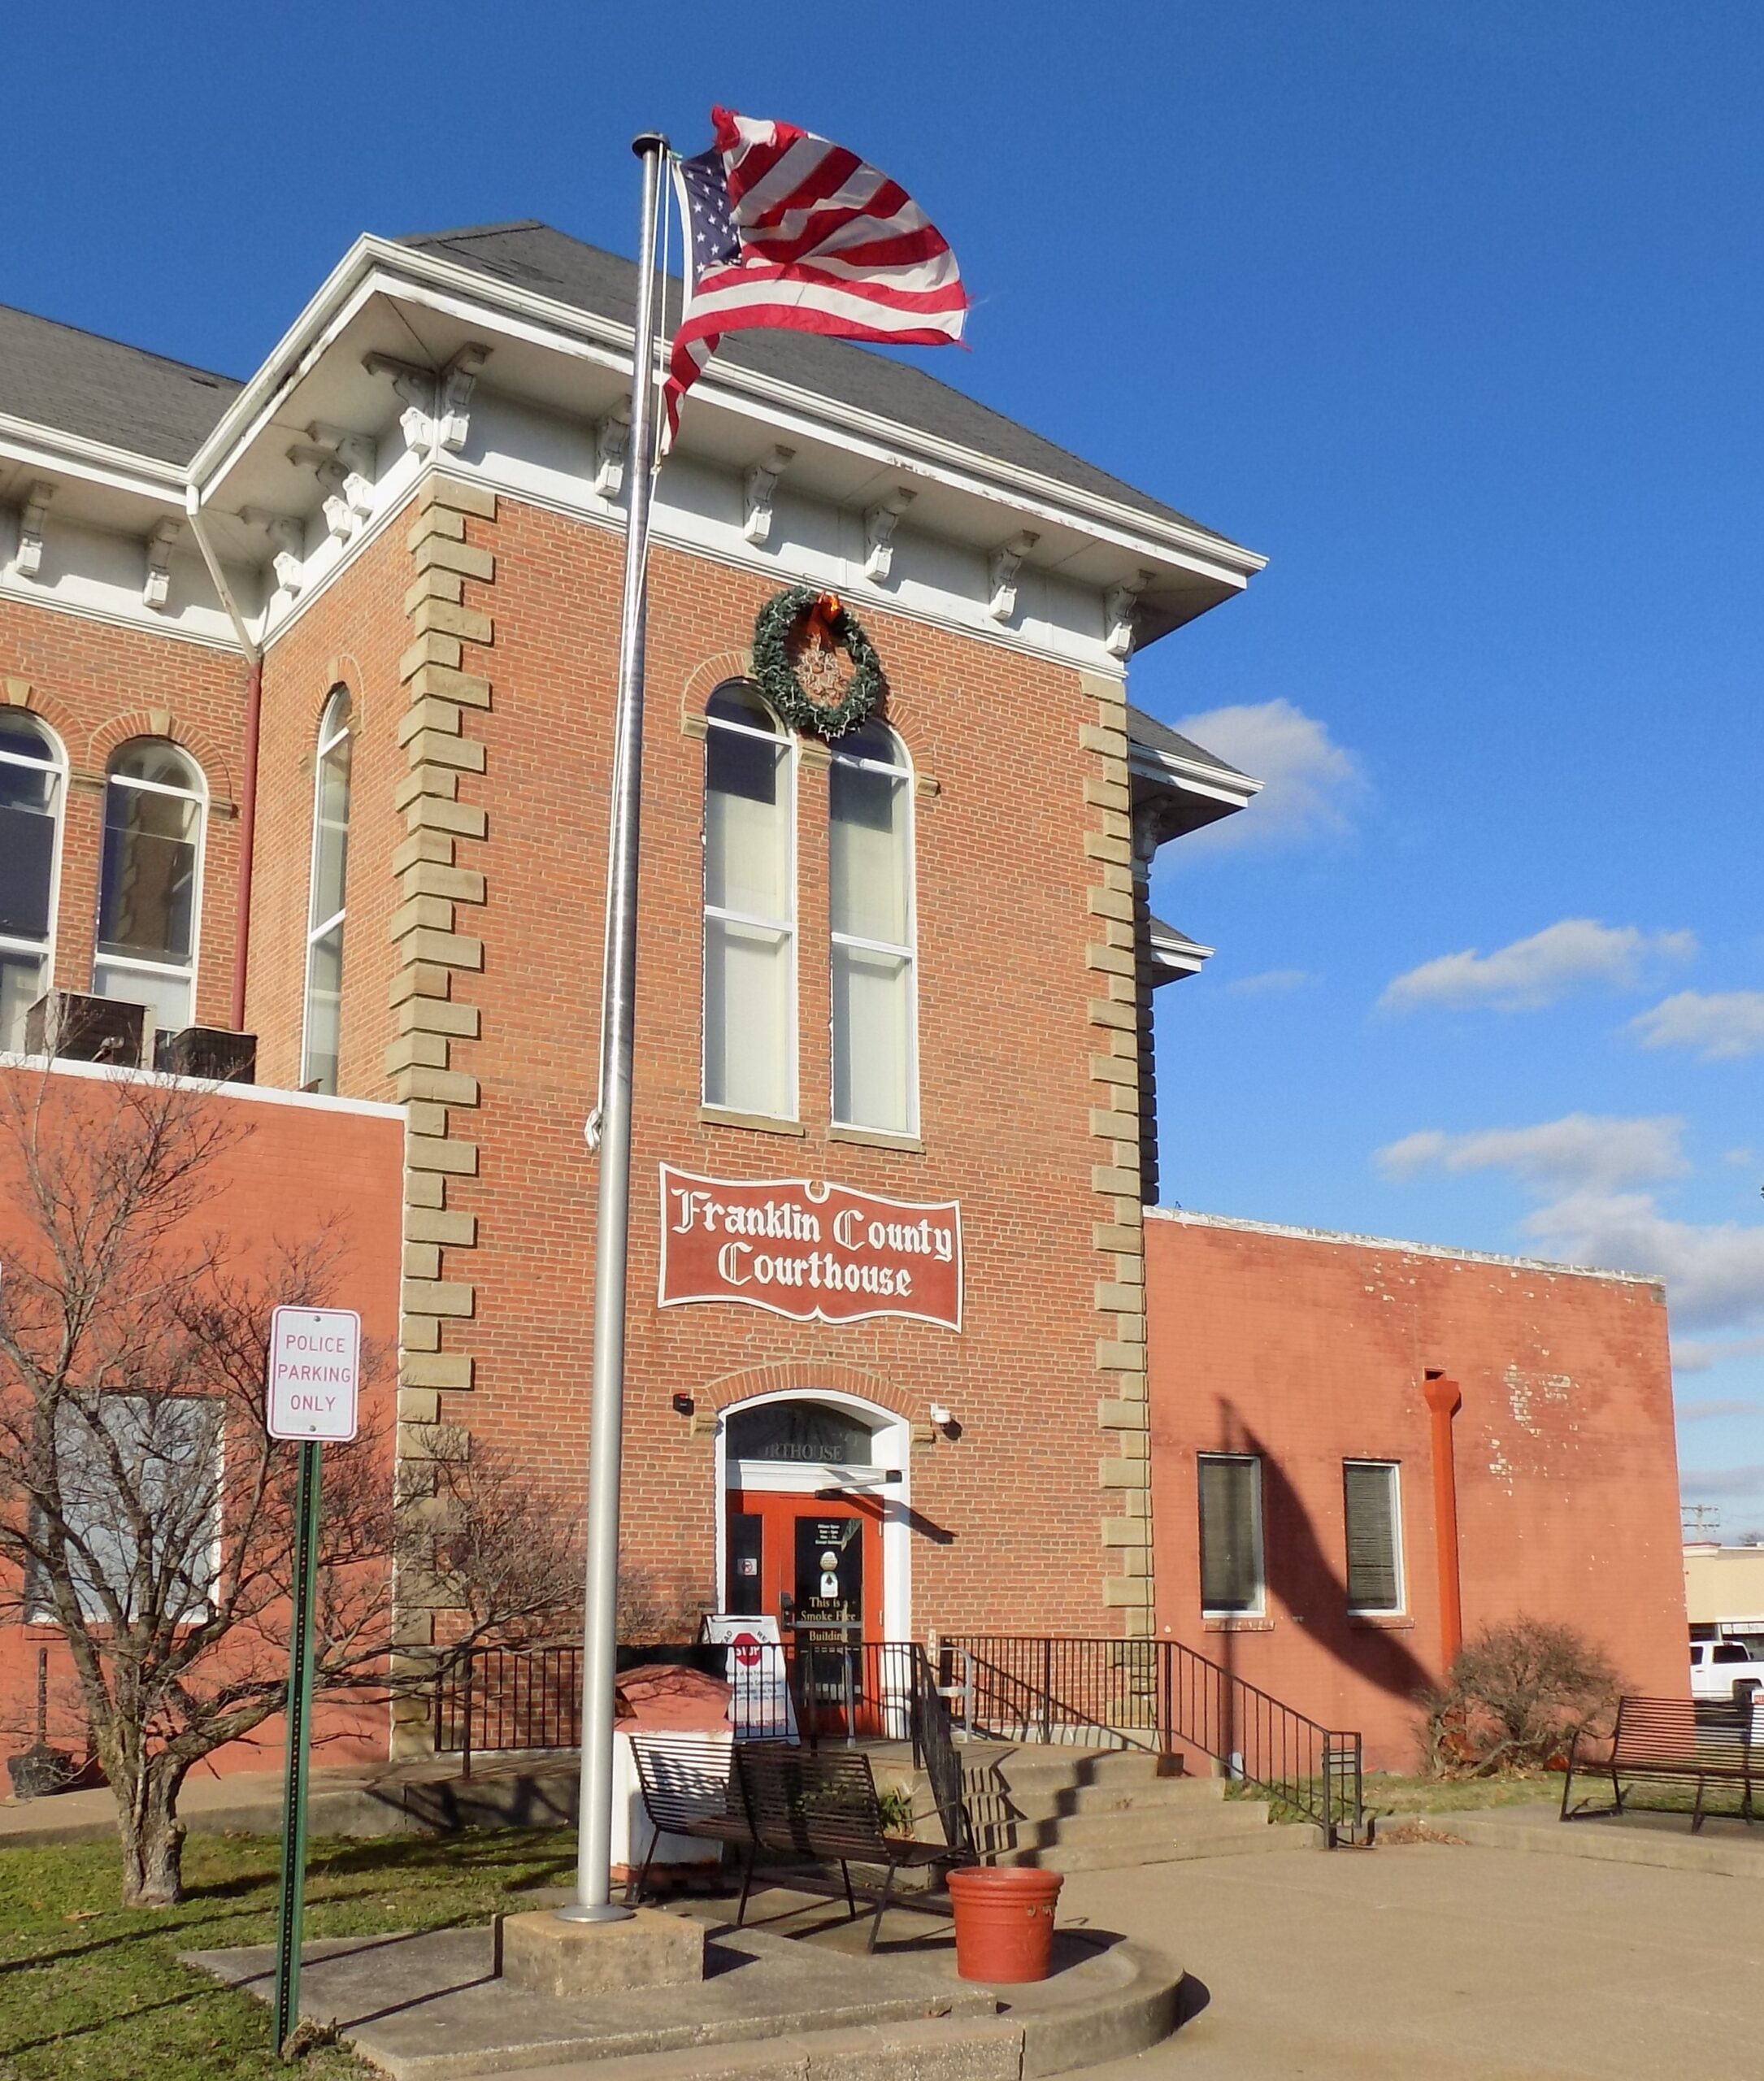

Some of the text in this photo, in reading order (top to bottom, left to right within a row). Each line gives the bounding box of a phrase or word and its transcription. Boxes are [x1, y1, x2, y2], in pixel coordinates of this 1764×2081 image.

[671, 1187, 953, 1262] Franklin County
[718, 1241, 913, 1297] Courthouse
[286, 1335, 345, 1353] POLICE
[278, 1364, 351, 1382] PARKING
[290, 1395, 337, 1412] ONLY
[809, 1597, 830, 1608] This
[833, 1598, 841, 1608] is
[801, 1610, 856, 1621] Smoke Fee
